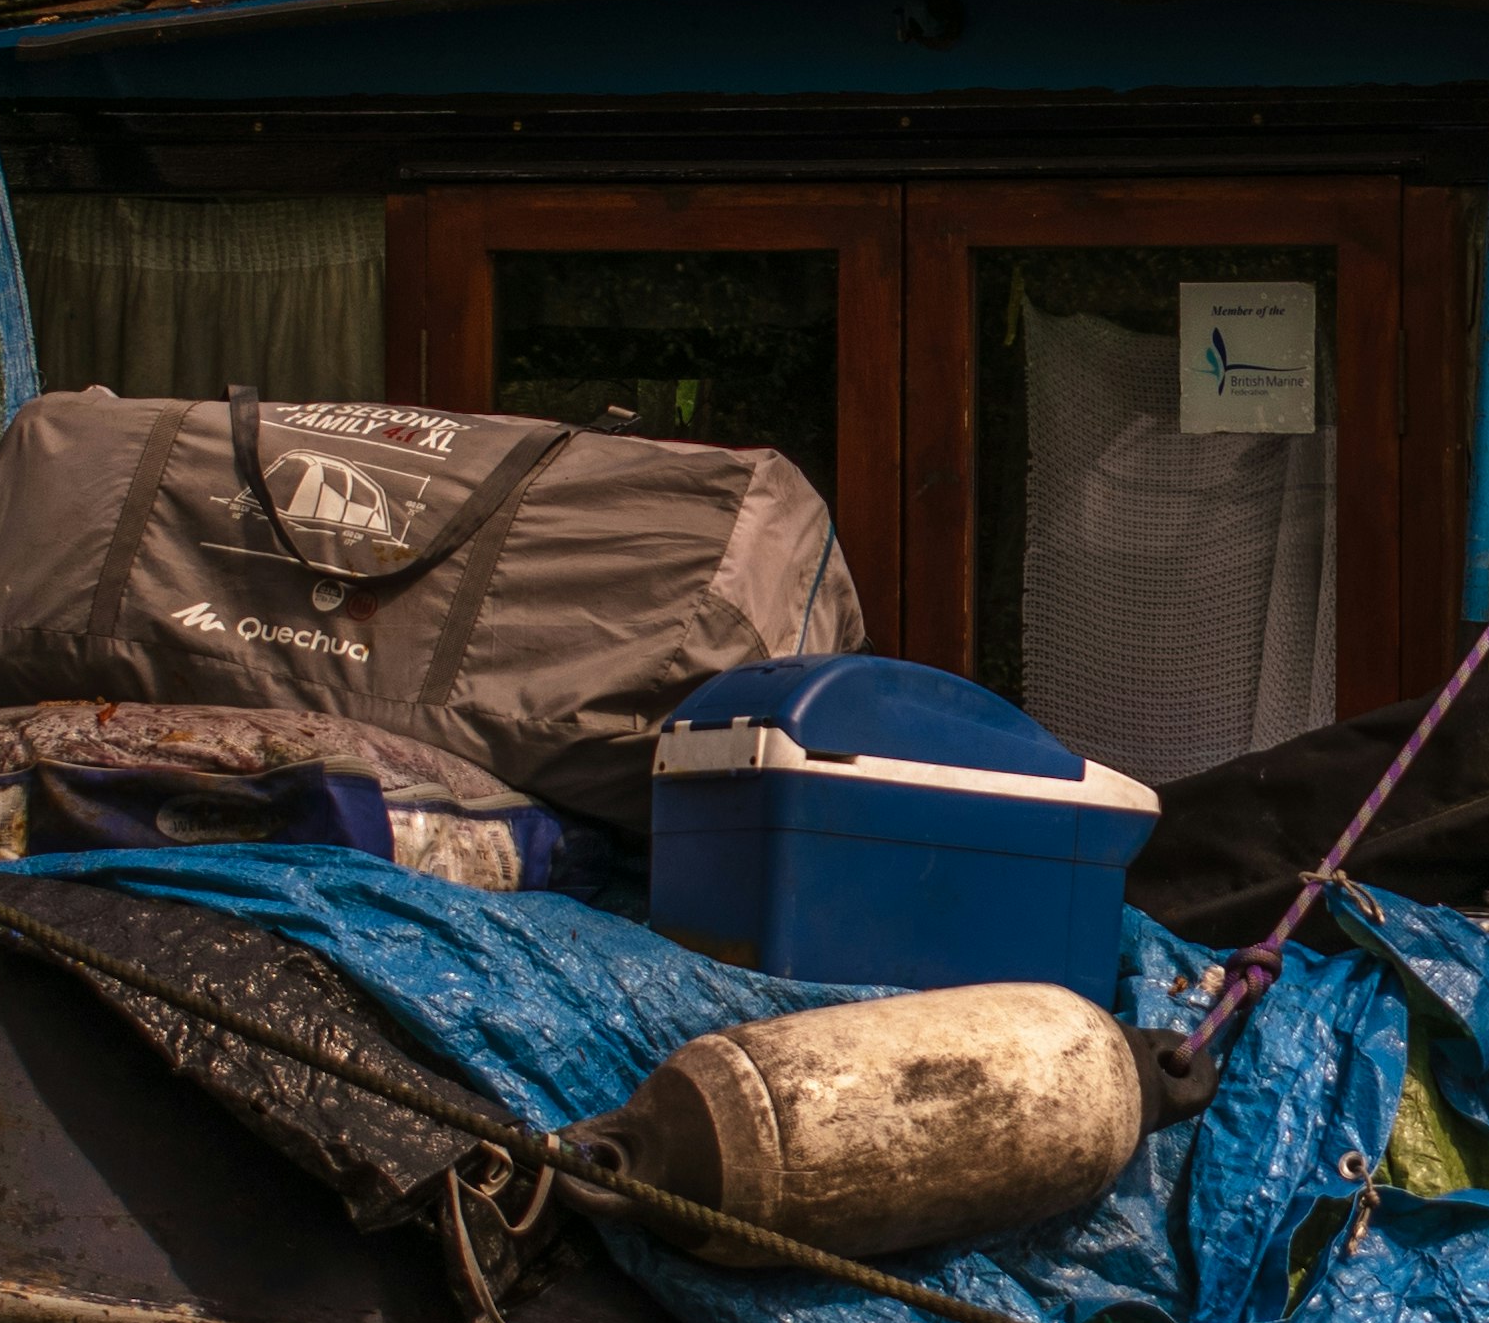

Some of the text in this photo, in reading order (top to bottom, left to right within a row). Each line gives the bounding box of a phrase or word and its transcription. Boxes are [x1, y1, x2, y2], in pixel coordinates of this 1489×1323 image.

[1211, 305, 1286, 318] Member of the
[1231, 375, 1304, 387] British Marine
[284, 411, 385, 435] FAMILY
[418, 428, 459, 453] XL
[237, 616, 370, 663] Quechua
